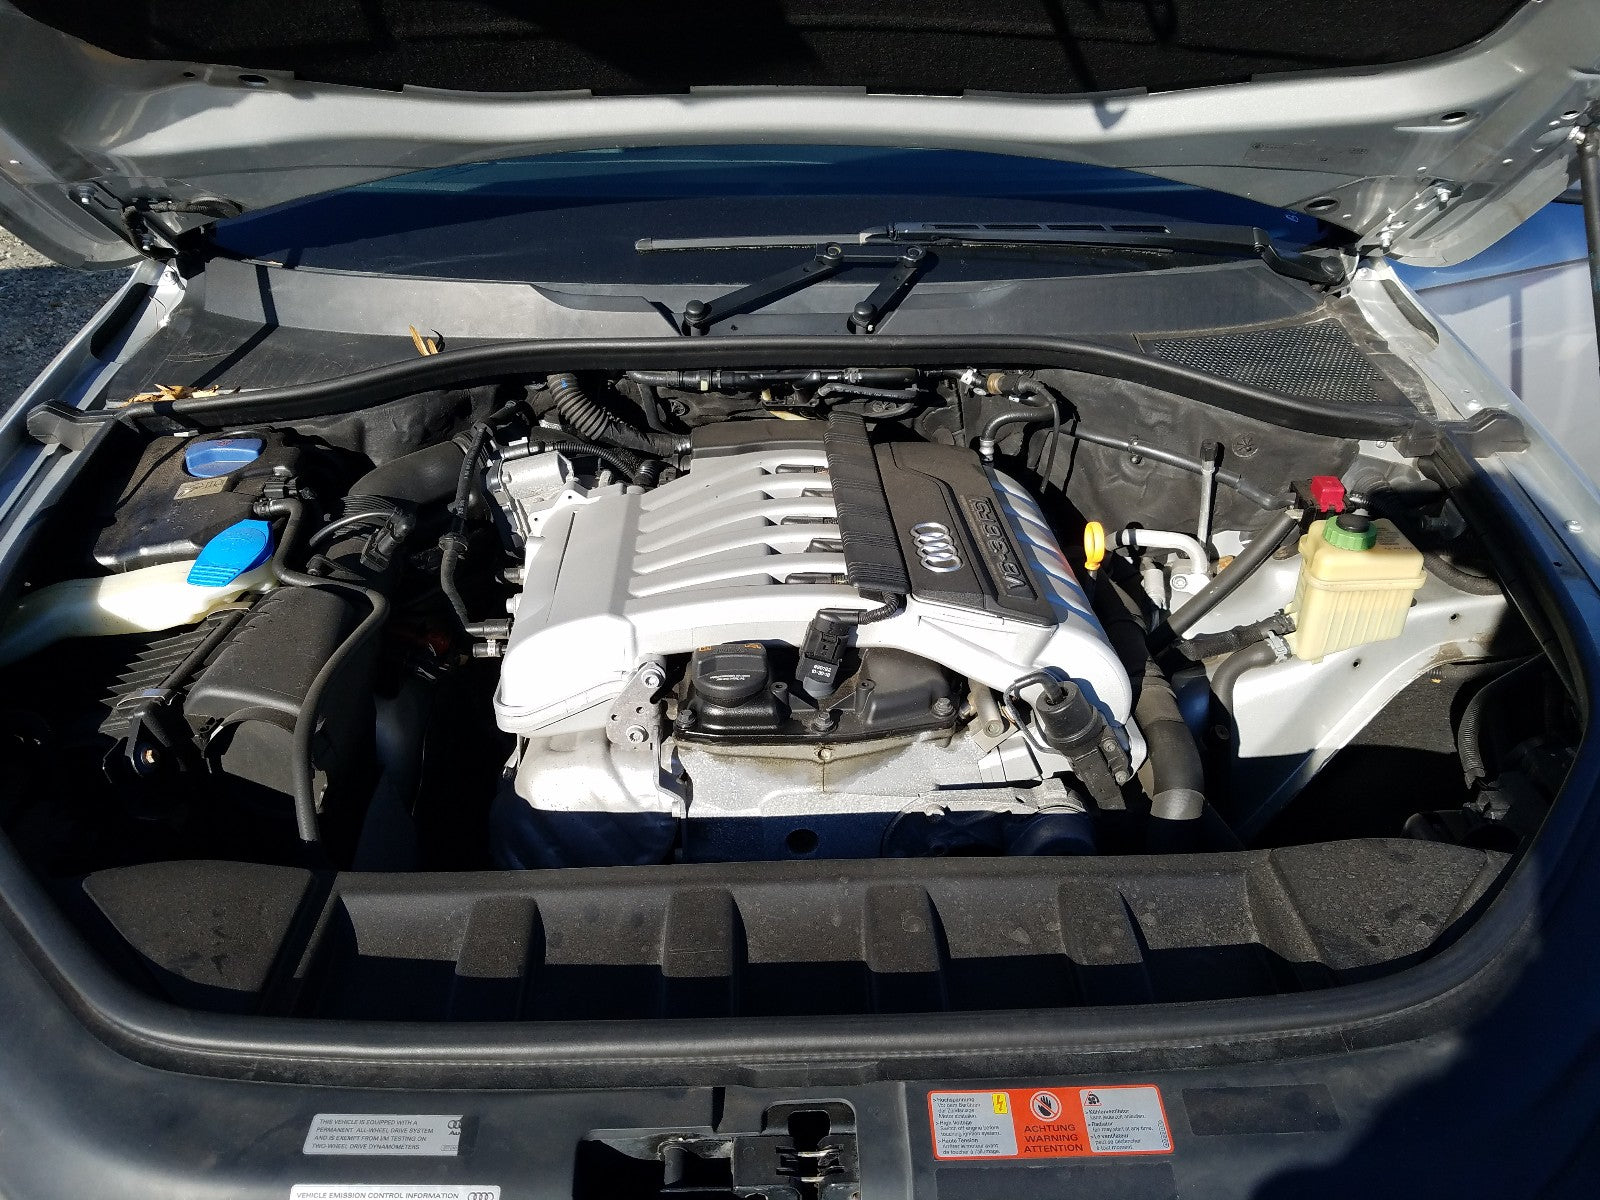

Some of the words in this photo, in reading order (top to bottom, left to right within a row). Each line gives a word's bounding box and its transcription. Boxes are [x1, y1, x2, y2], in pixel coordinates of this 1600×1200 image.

[1024, 1123, 1076, 1133] ACHTUNG
[1024, 1133, 1079, 1143] WARNING
[1024, 1143, 1084, 1153] ATTENTION
